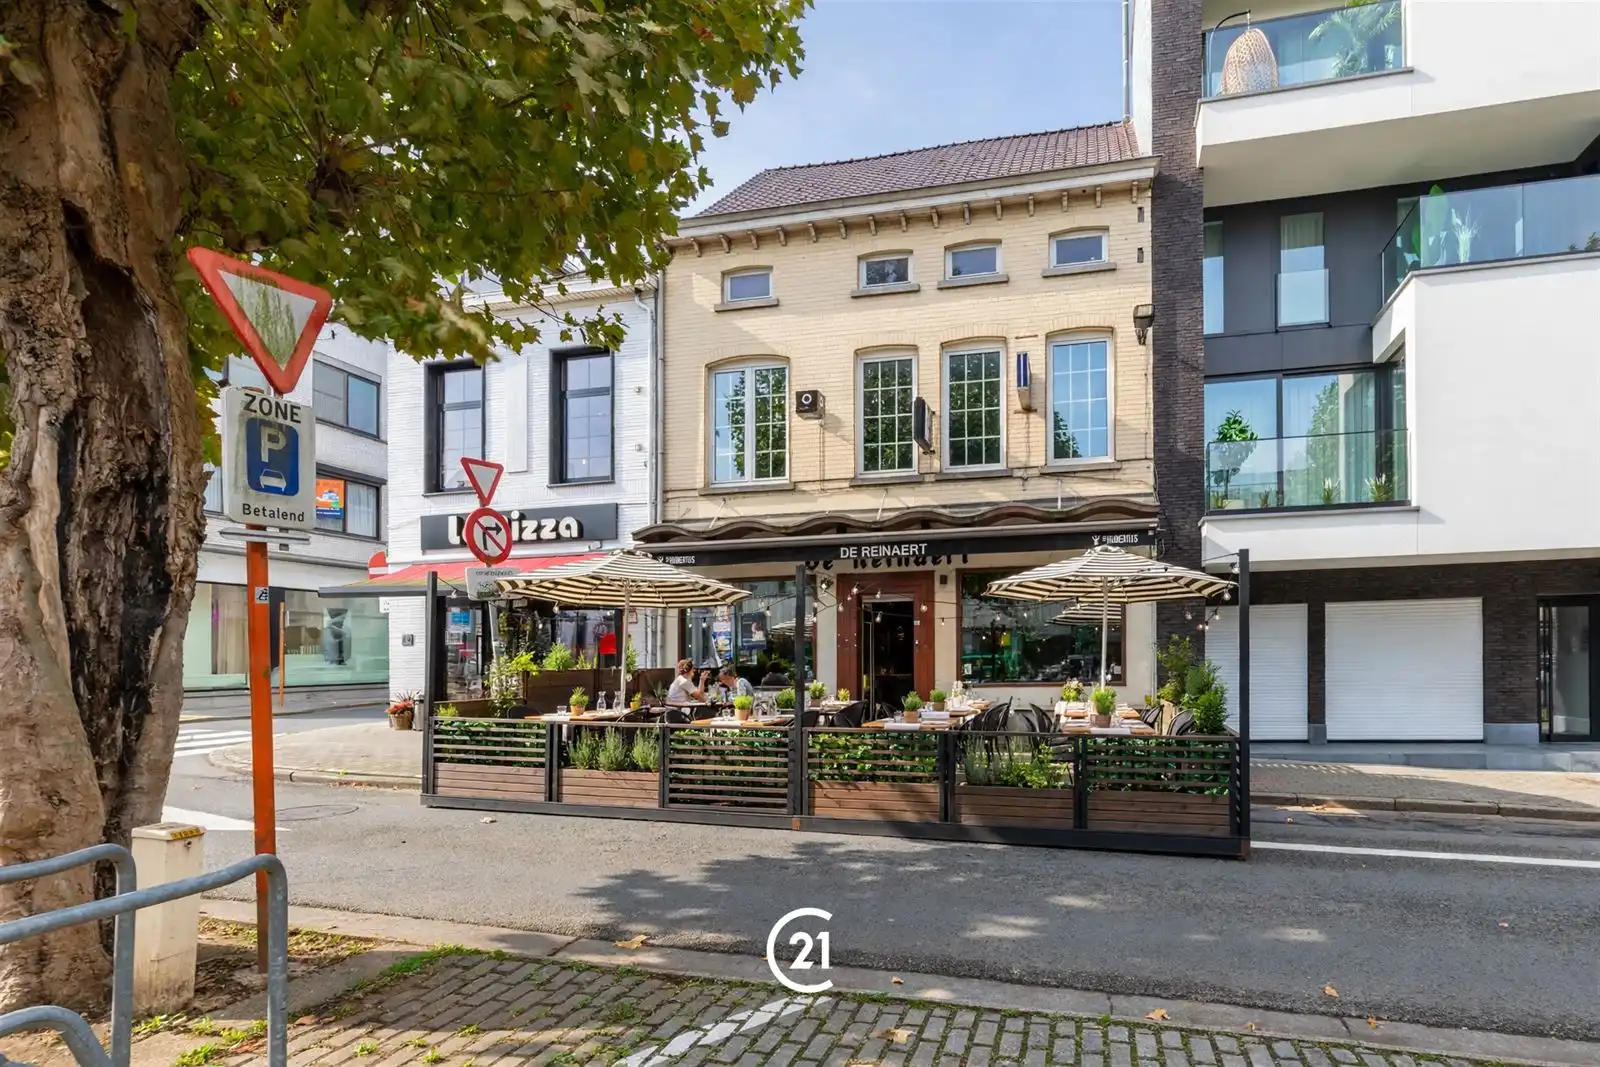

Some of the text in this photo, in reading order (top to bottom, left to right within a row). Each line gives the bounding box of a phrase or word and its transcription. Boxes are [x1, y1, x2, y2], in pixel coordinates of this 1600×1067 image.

[244, 393, 302, 424] ZONE
[260, 425, 287, 463] P
[242, 503, 305, 522] Betalend
[840, 543, 928, 559] DE REINAERT
